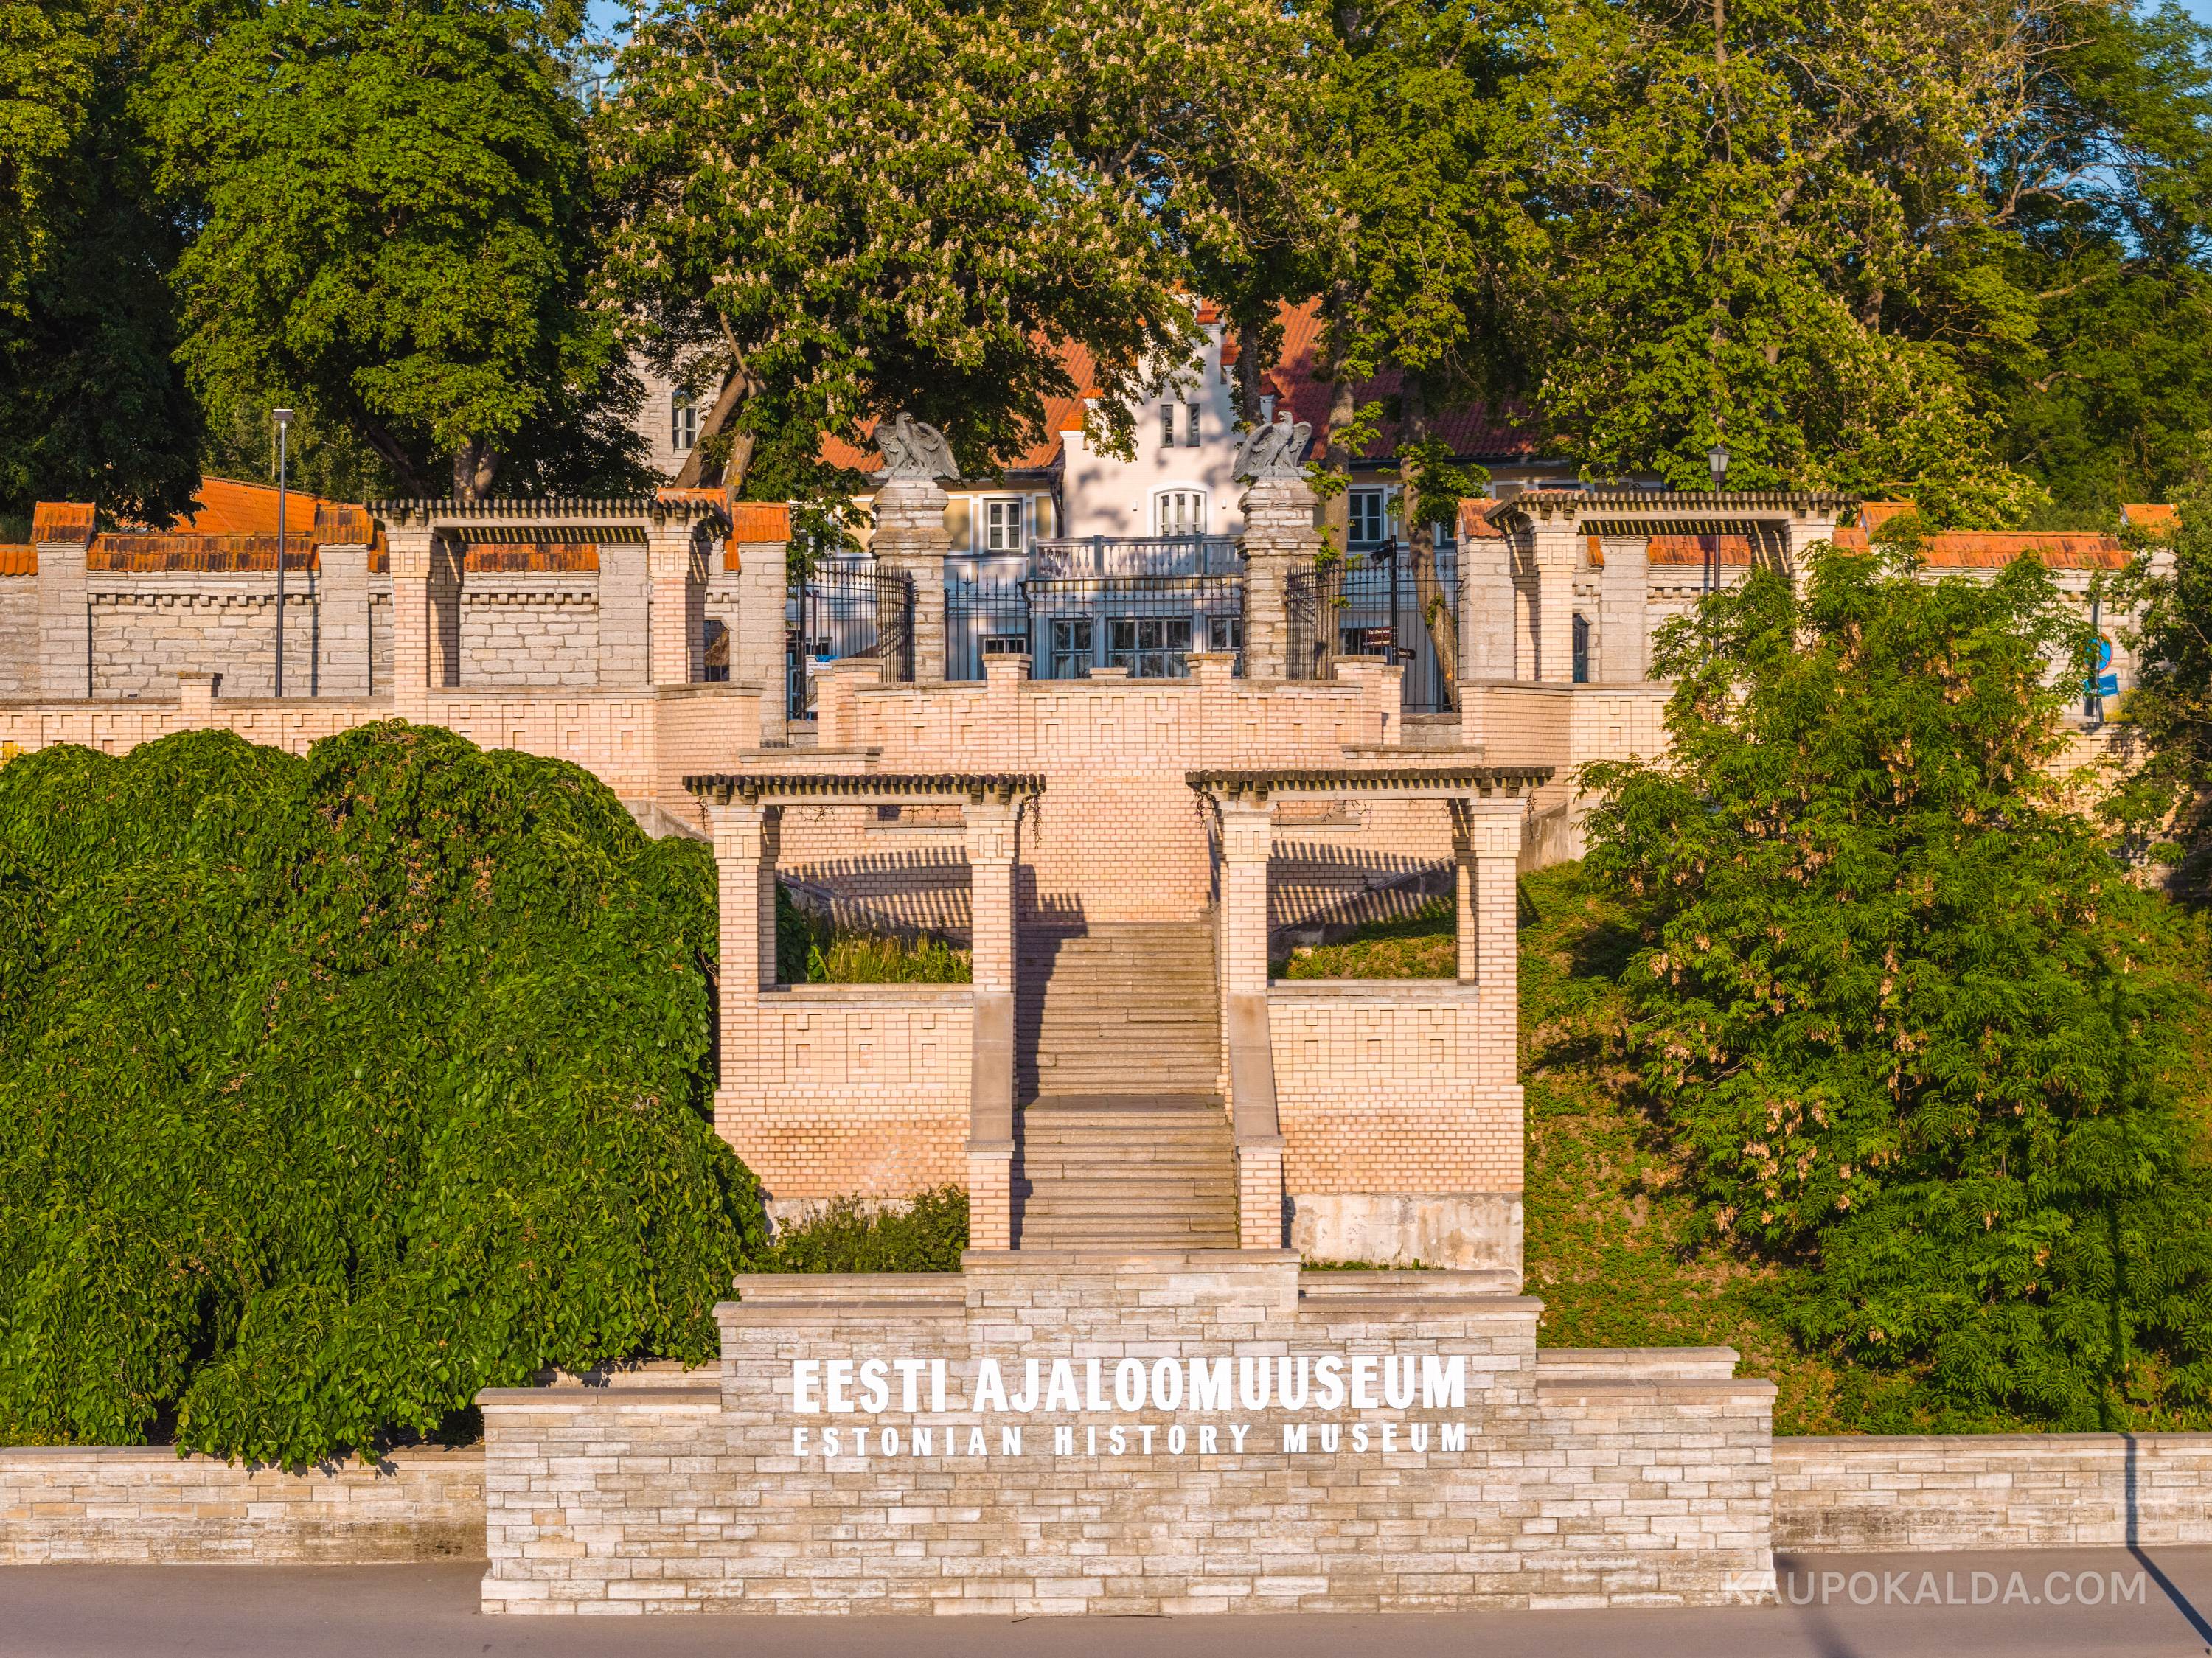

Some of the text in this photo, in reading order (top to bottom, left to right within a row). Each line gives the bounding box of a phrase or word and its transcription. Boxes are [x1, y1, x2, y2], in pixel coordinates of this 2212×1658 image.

[793, 1355, 1466, 1413] EESTI AJALOOMUUSEUM
[793, 1422, 1466, 1457] ESTONIAN HISTORY MUSEUM
